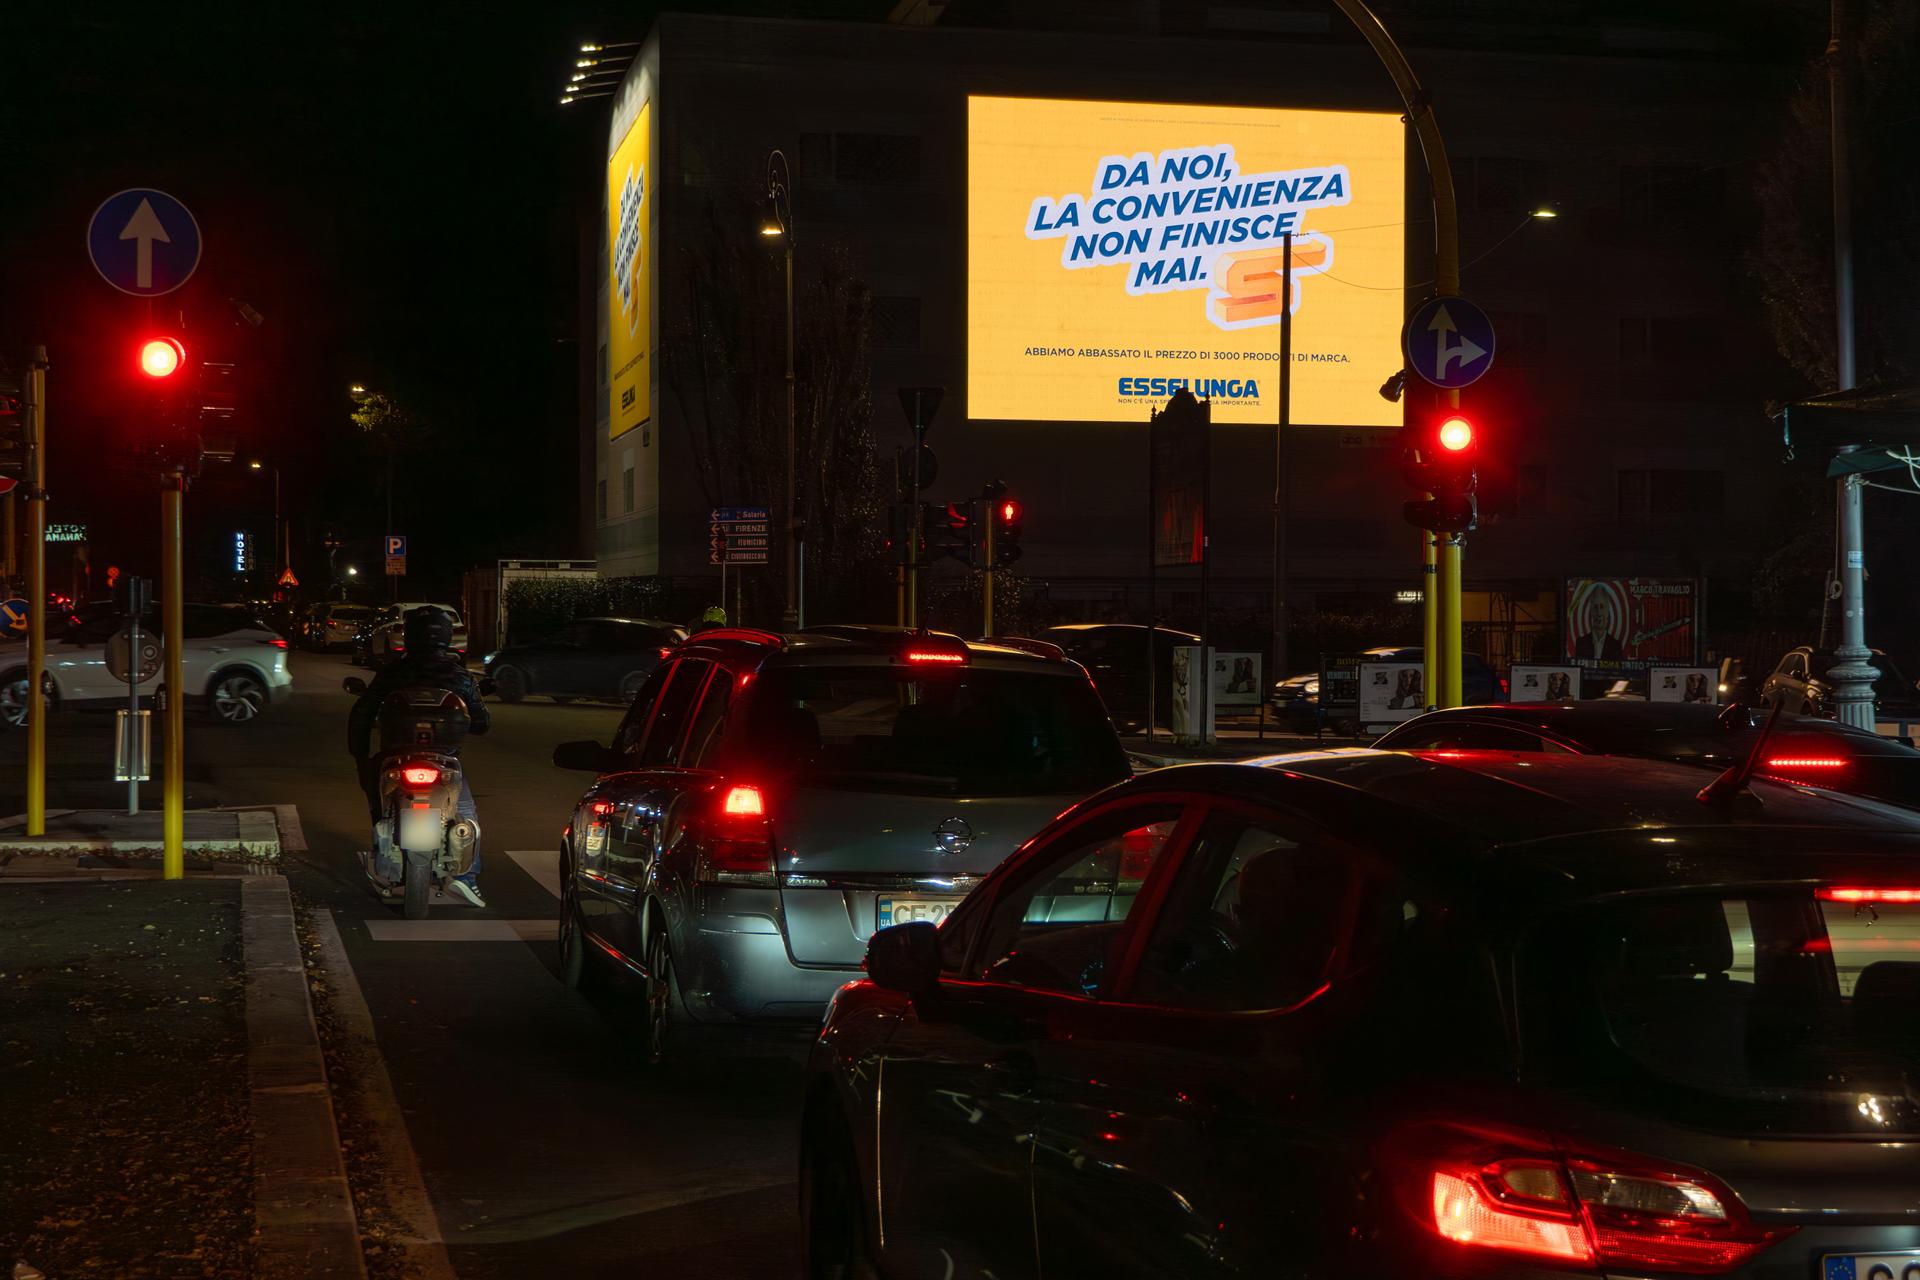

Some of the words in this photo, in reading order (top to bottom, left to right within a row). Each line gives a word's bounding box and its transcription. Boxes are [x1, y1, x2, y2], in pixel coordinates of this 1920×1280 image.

[1100, 160, 1150, 190] DA
[1160, 153, 1232, 183] NOI,
[1033, 202, 1080, 231] LA
[1092, 173, 1344, 225] CONVENIENZA
[1070, 228, 1153, 261] NON
[1159, 211, 1297, 249] FINISCE
[1133, 256, 1207, 287] MAI.
[1024, 347, 1075, 357] ABBIAMO
[1077, 348, 1141, 358] ABBASSATO
[1143, 350, 1153, 359] IL
[1155, 350, 1197, 360] PREZZO
[1199, 351, 1211, 360] DI
[1213, 351, 1240, 361] 3000
[1242, 352, 1296, 362] PRODOI
[1297, 353, 1308, 362] DI
[1310, 353, 1350, 363] MARCA.
[1118, 377, 1259, 399] ESSELUNGA
[1220, 399, 1262, 407] IMPORTANTE.
[735, 525, 766, 533] FIRENZE
[236, 531, 246, 572] HOTEL
